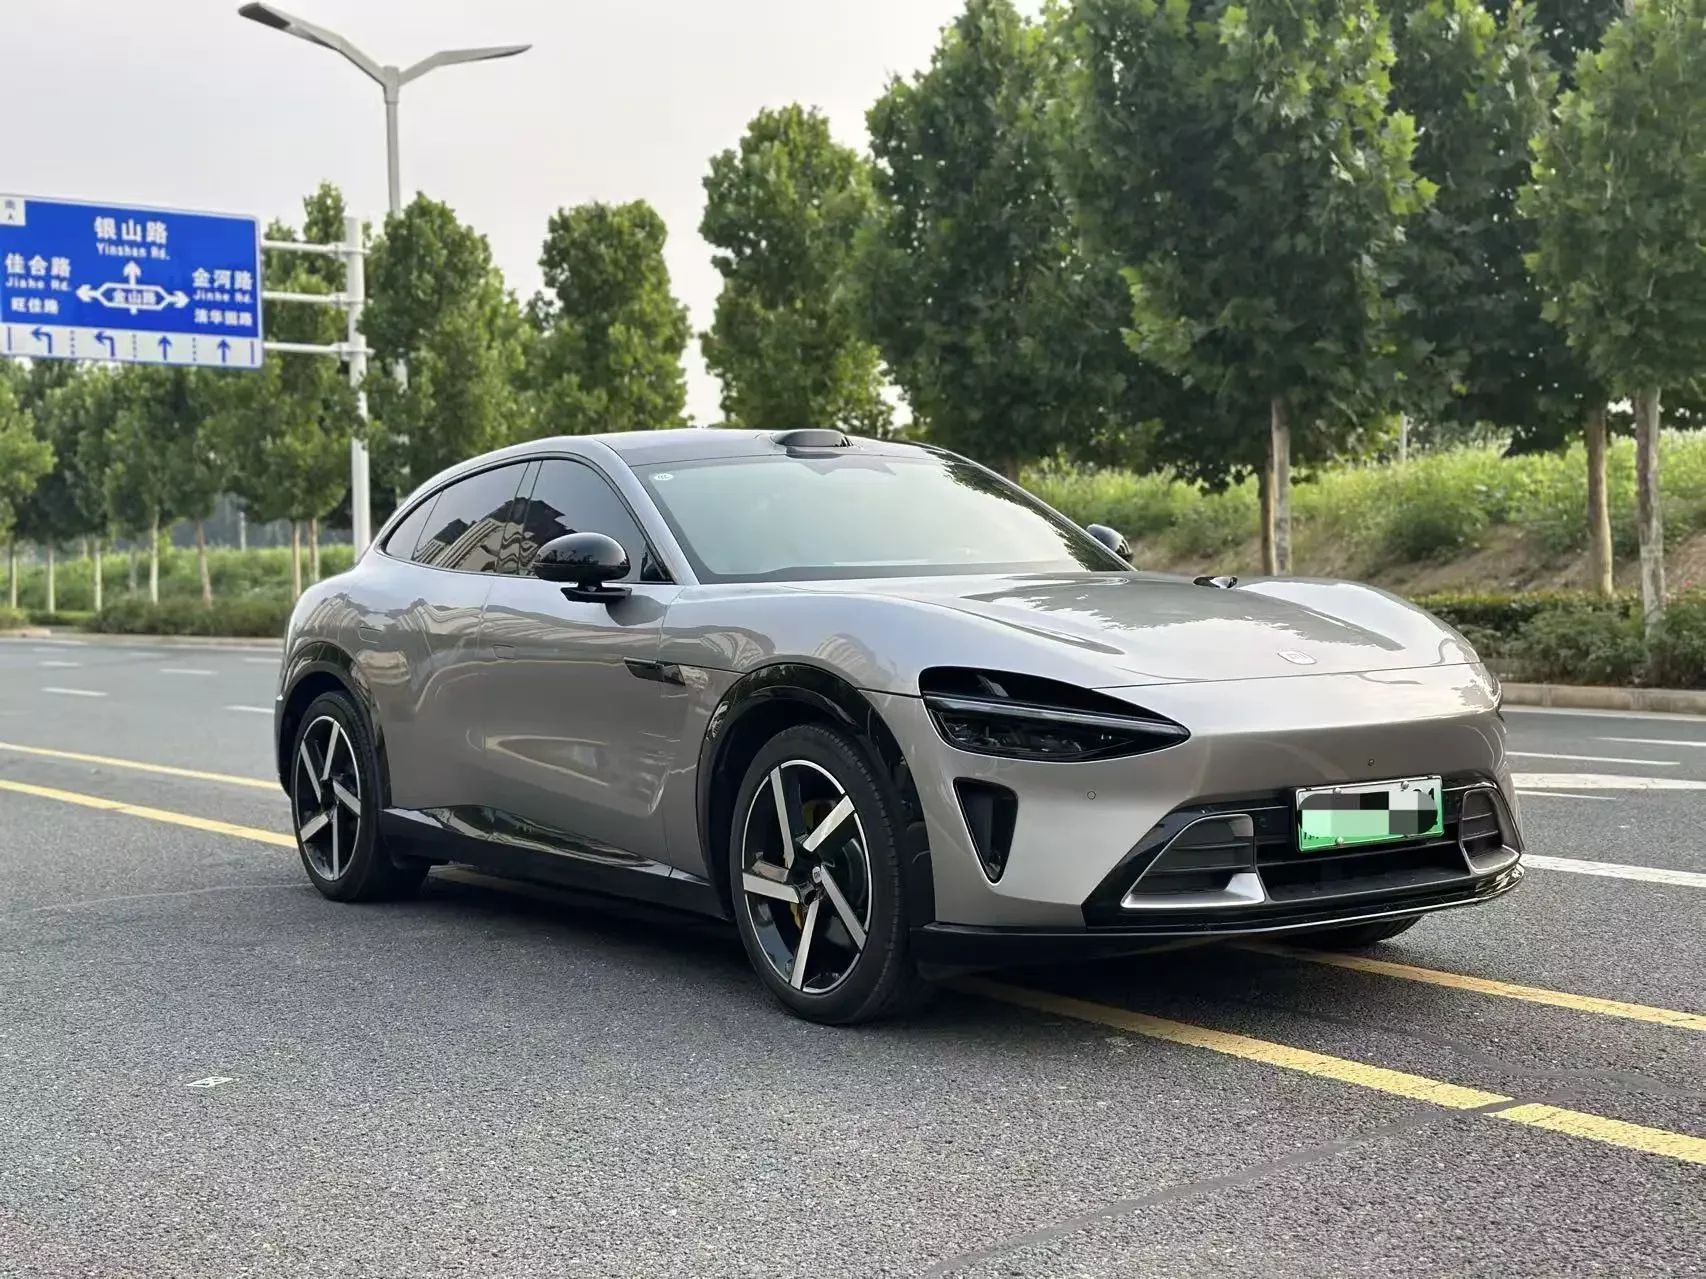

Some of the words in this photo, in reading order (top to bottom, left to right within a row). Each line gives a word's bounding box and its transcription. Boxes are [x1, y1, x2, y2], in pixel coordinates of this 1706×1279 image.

[94, 216, 168, 245] 银山路
[96, 242, 147, 257] Yinshan
[5, 252, 71, 278] 佳合路
[192, 267, 253, 290] 金河路
